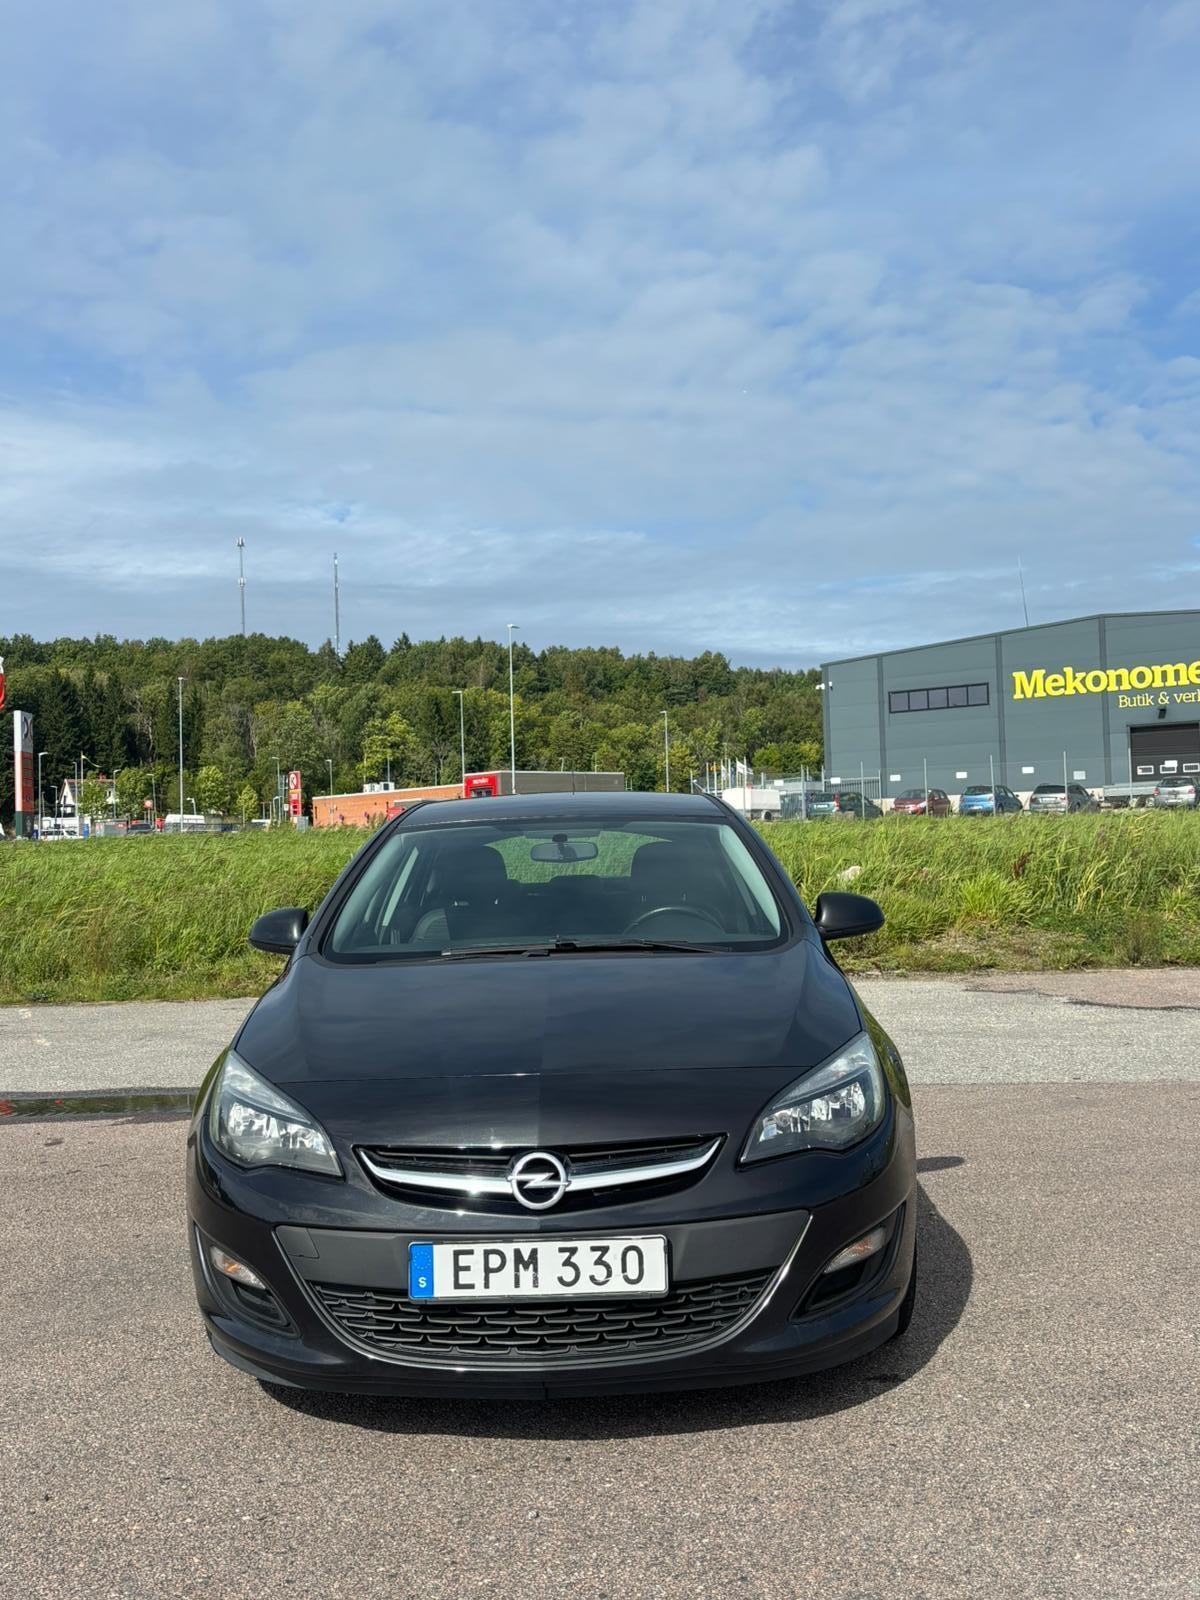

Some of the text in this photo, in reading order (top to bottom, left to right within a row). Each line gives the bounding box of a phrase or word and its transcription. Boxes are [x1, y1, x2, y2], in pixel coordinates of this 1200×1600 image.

[1118, 693, 1154, 708] Butik
[1158, 691, 1170, 705] &
[452, 1244, 645, 1290] EPM 330
[418, 1276, 427, 1288] S
